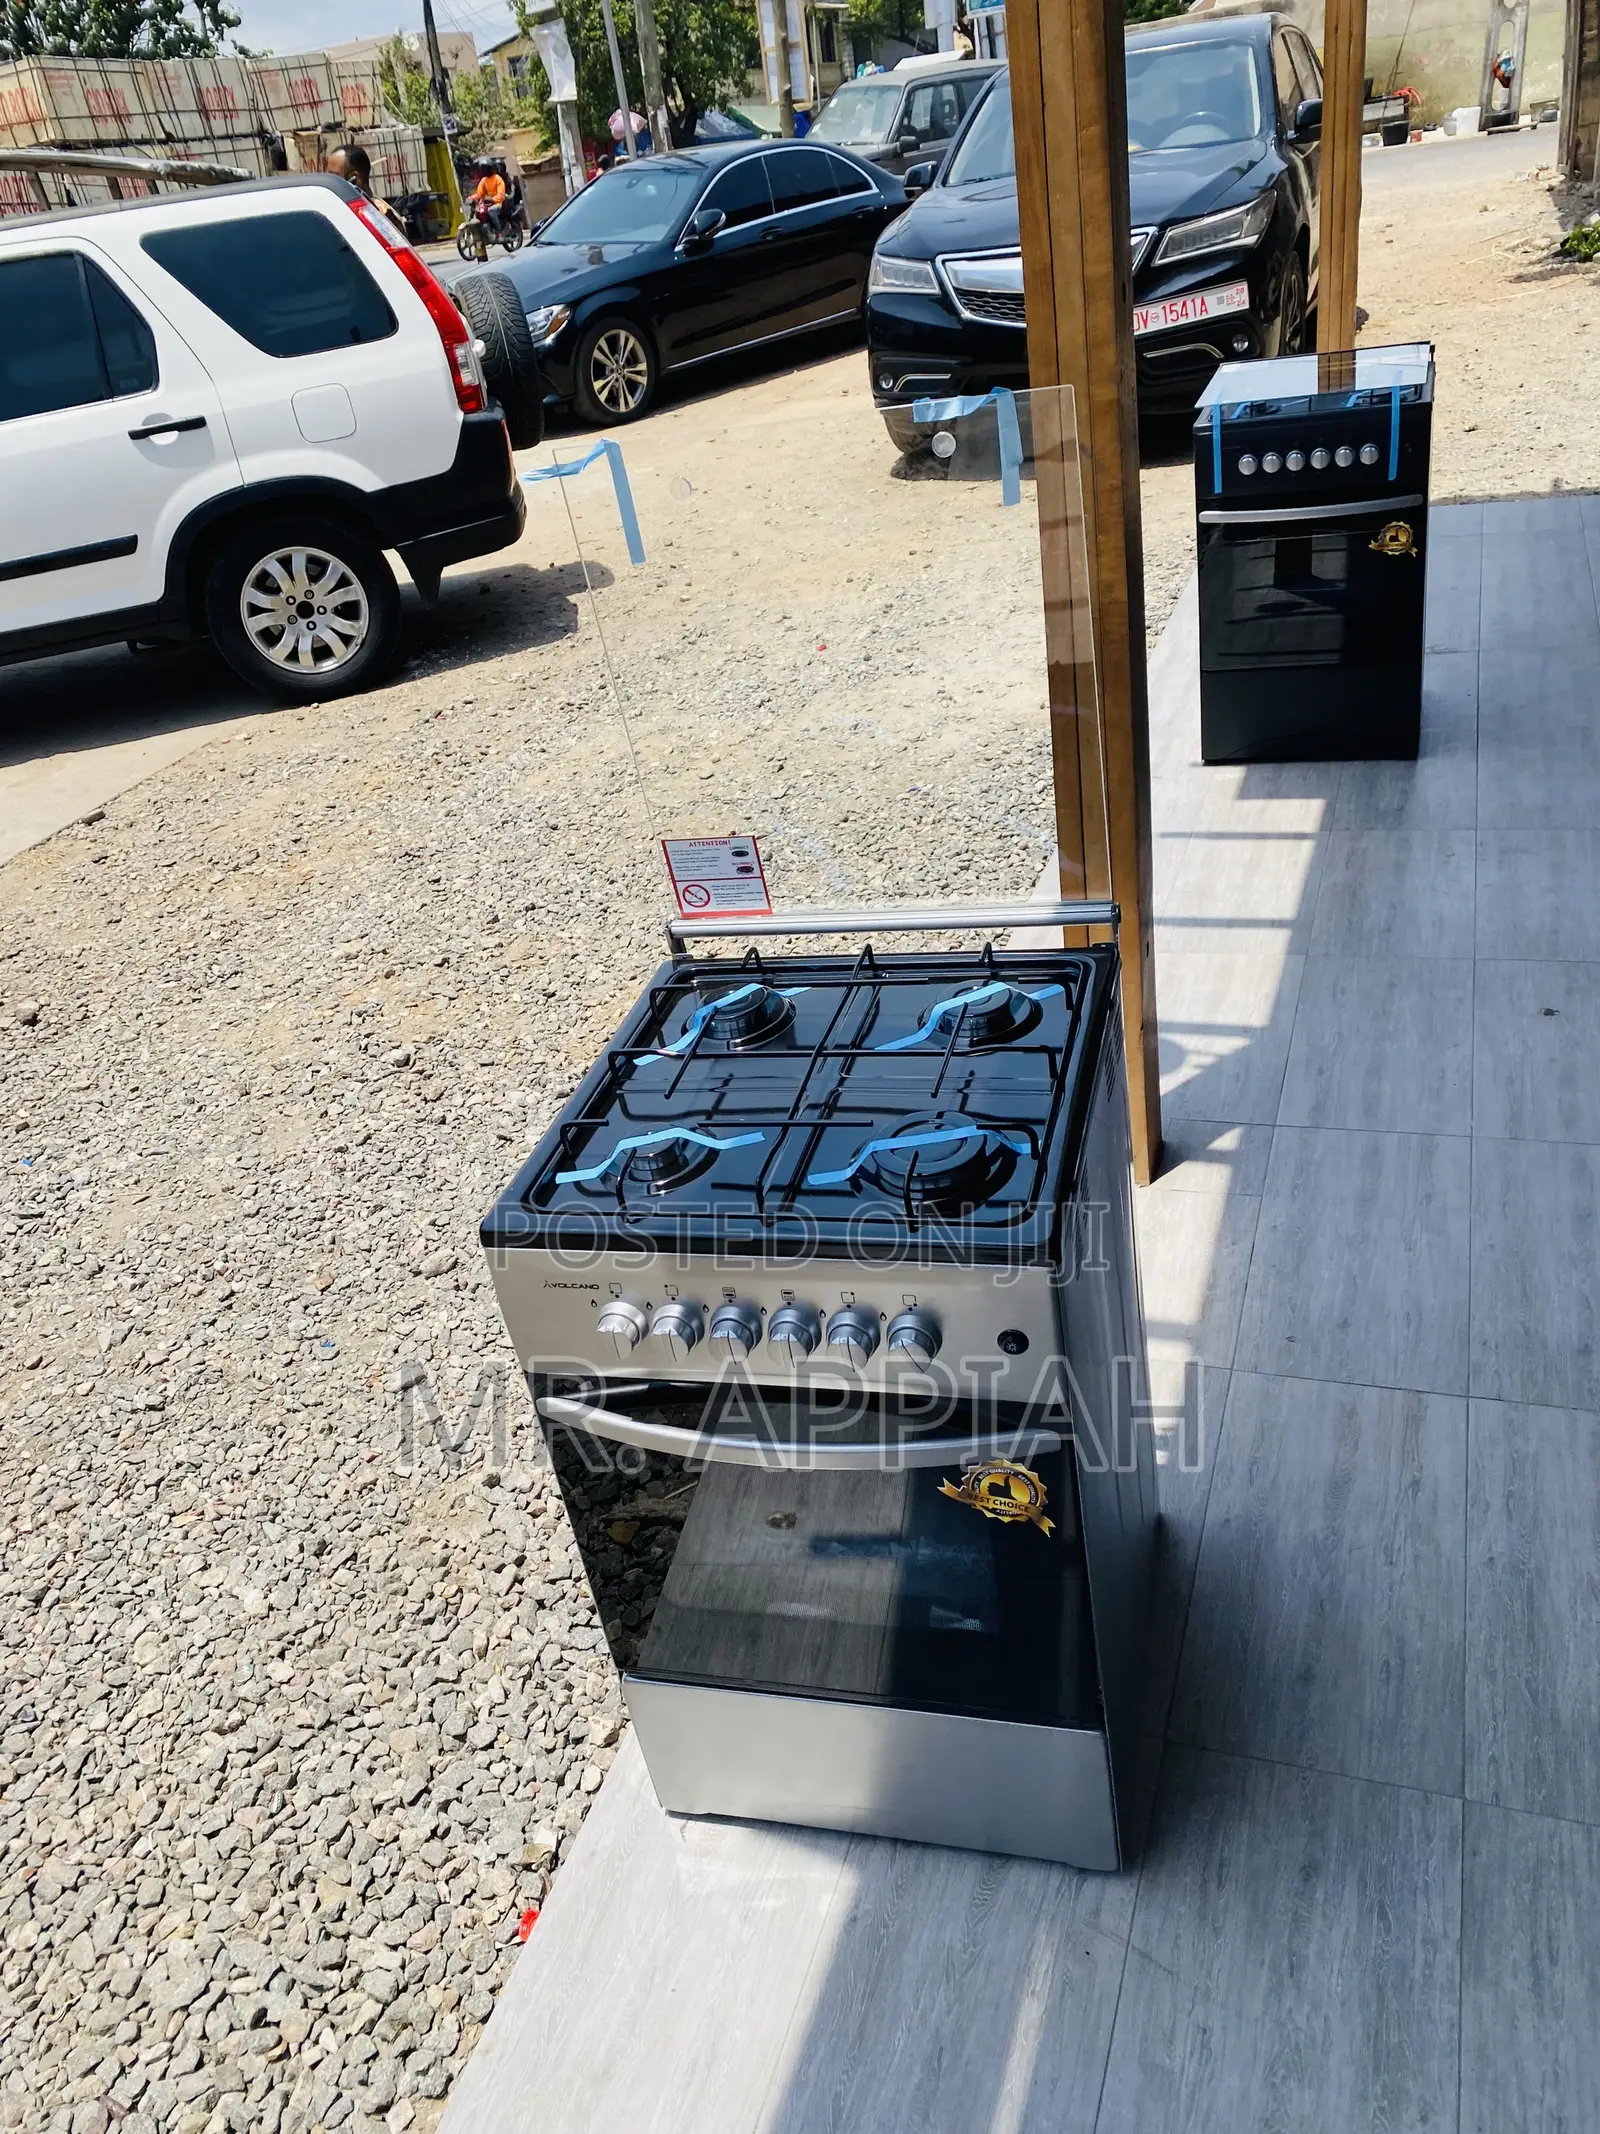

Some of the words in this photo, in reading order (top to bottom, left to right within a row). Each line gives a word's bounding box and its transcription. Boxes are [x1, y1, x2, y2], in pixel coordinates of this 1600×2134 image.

[1161, 295, 1209, 324] 1541A
[689, 840, 731, 848] ATTENTION!
[968, 1491, 991, 1504] BEST
[993, 1499, 1030, 1512] CHOICE
